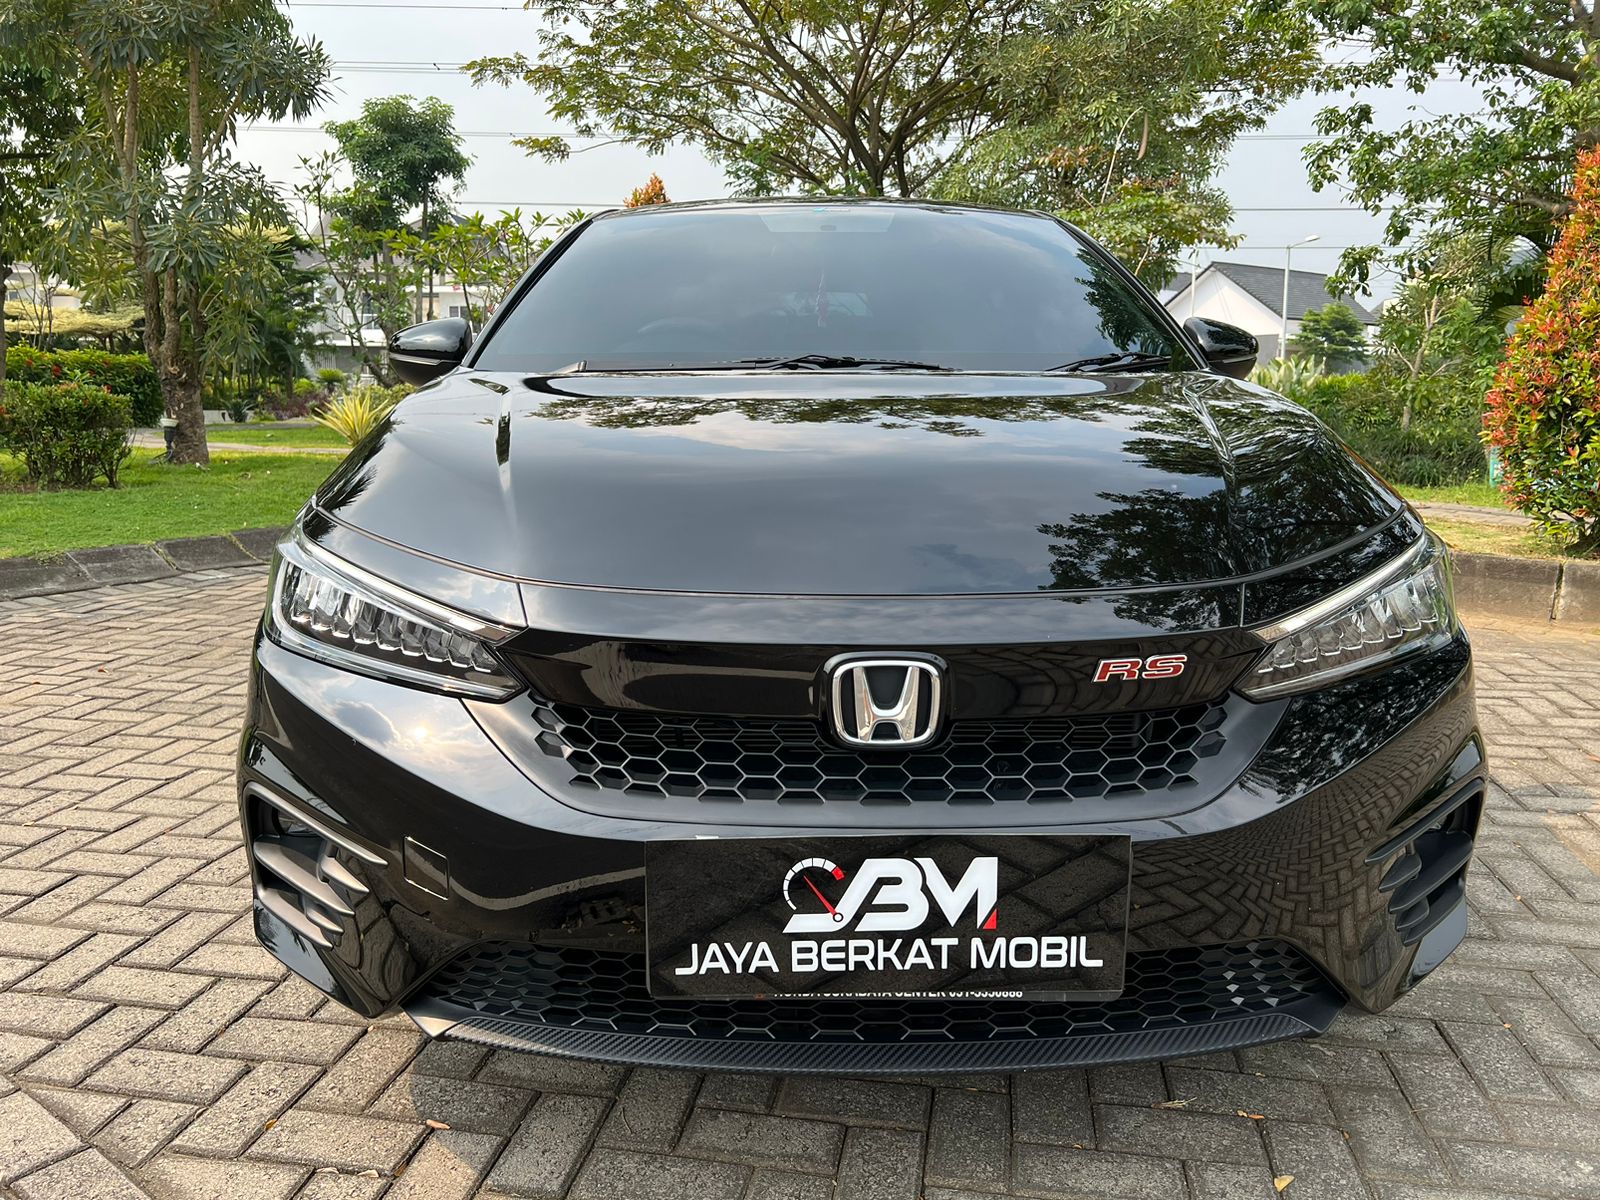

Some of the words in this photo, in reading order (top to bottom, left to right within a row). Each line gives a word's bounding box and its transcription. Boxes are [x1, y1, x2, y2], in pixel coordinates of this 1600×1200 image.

[1093, 654, 1188, 682] RS
[674, 941, 780, 976] JAYA
[791, 937, 959, 973] BERKAT
[970, 935, 1104, 969] MOBIL
